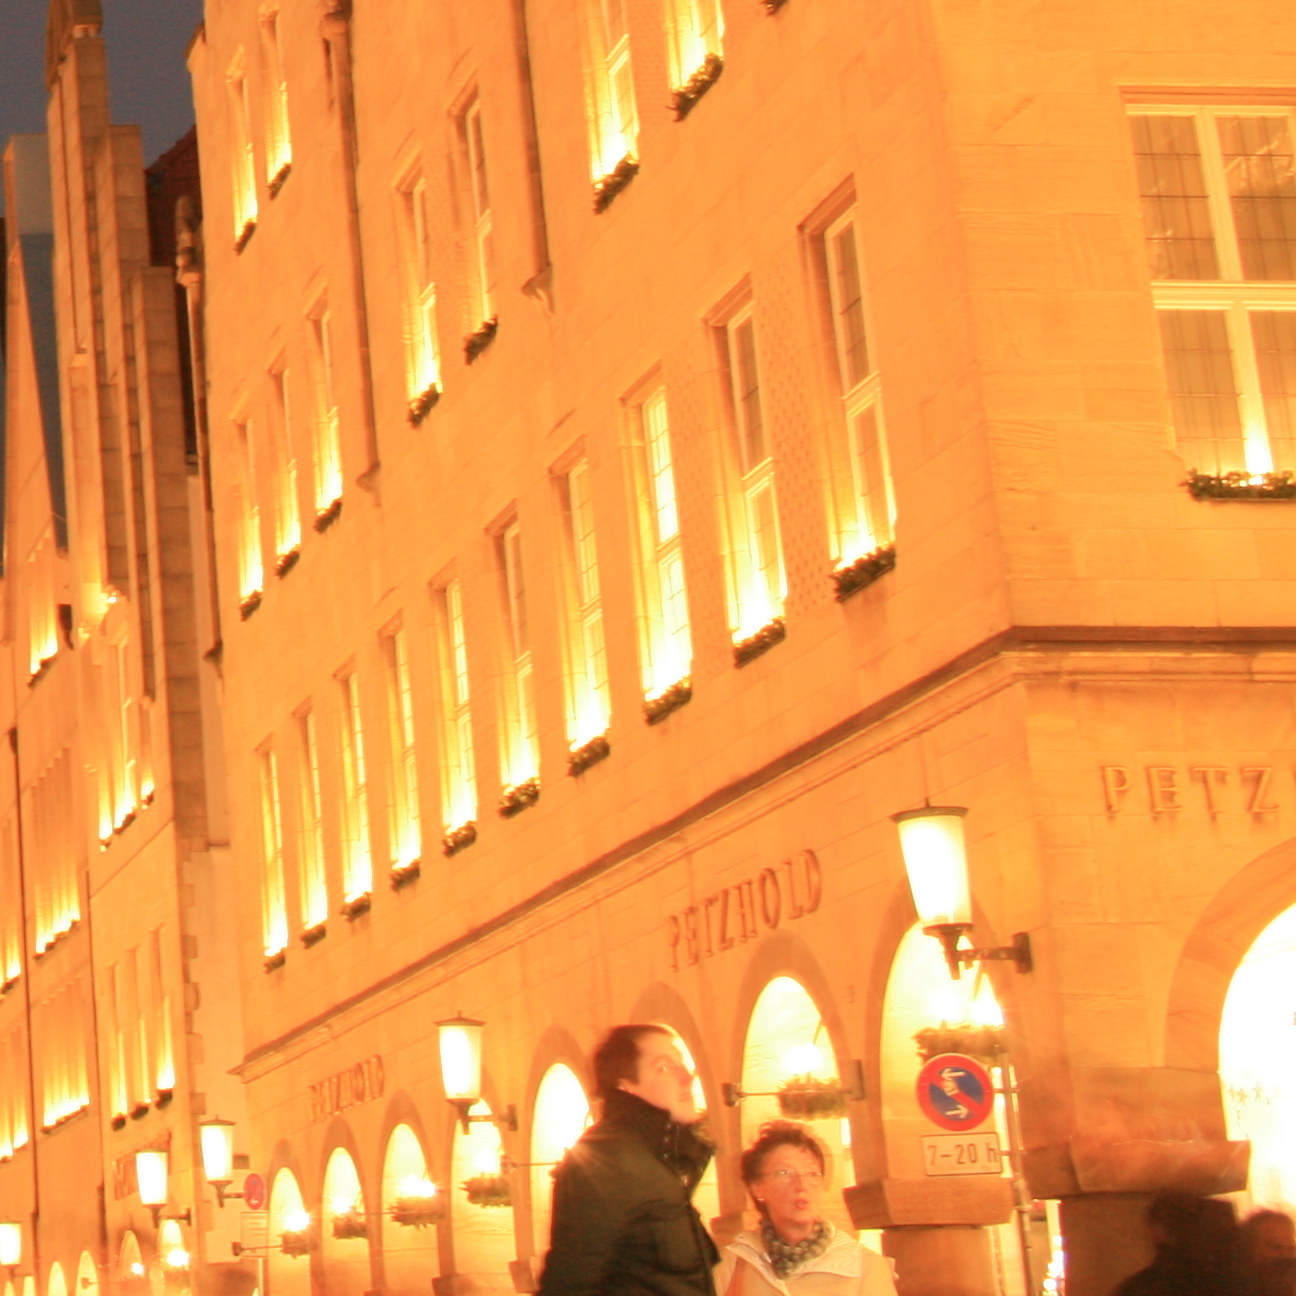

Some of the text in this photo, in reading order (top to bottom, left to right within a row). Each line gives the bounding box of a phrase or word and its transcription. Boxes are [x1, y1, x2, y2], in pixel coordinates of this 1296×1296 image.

[1099, 765, 1296, 815] PETZ
[667, 848, 822, 972] PETZHOLD
[985, 1142, 997, 1163] h
